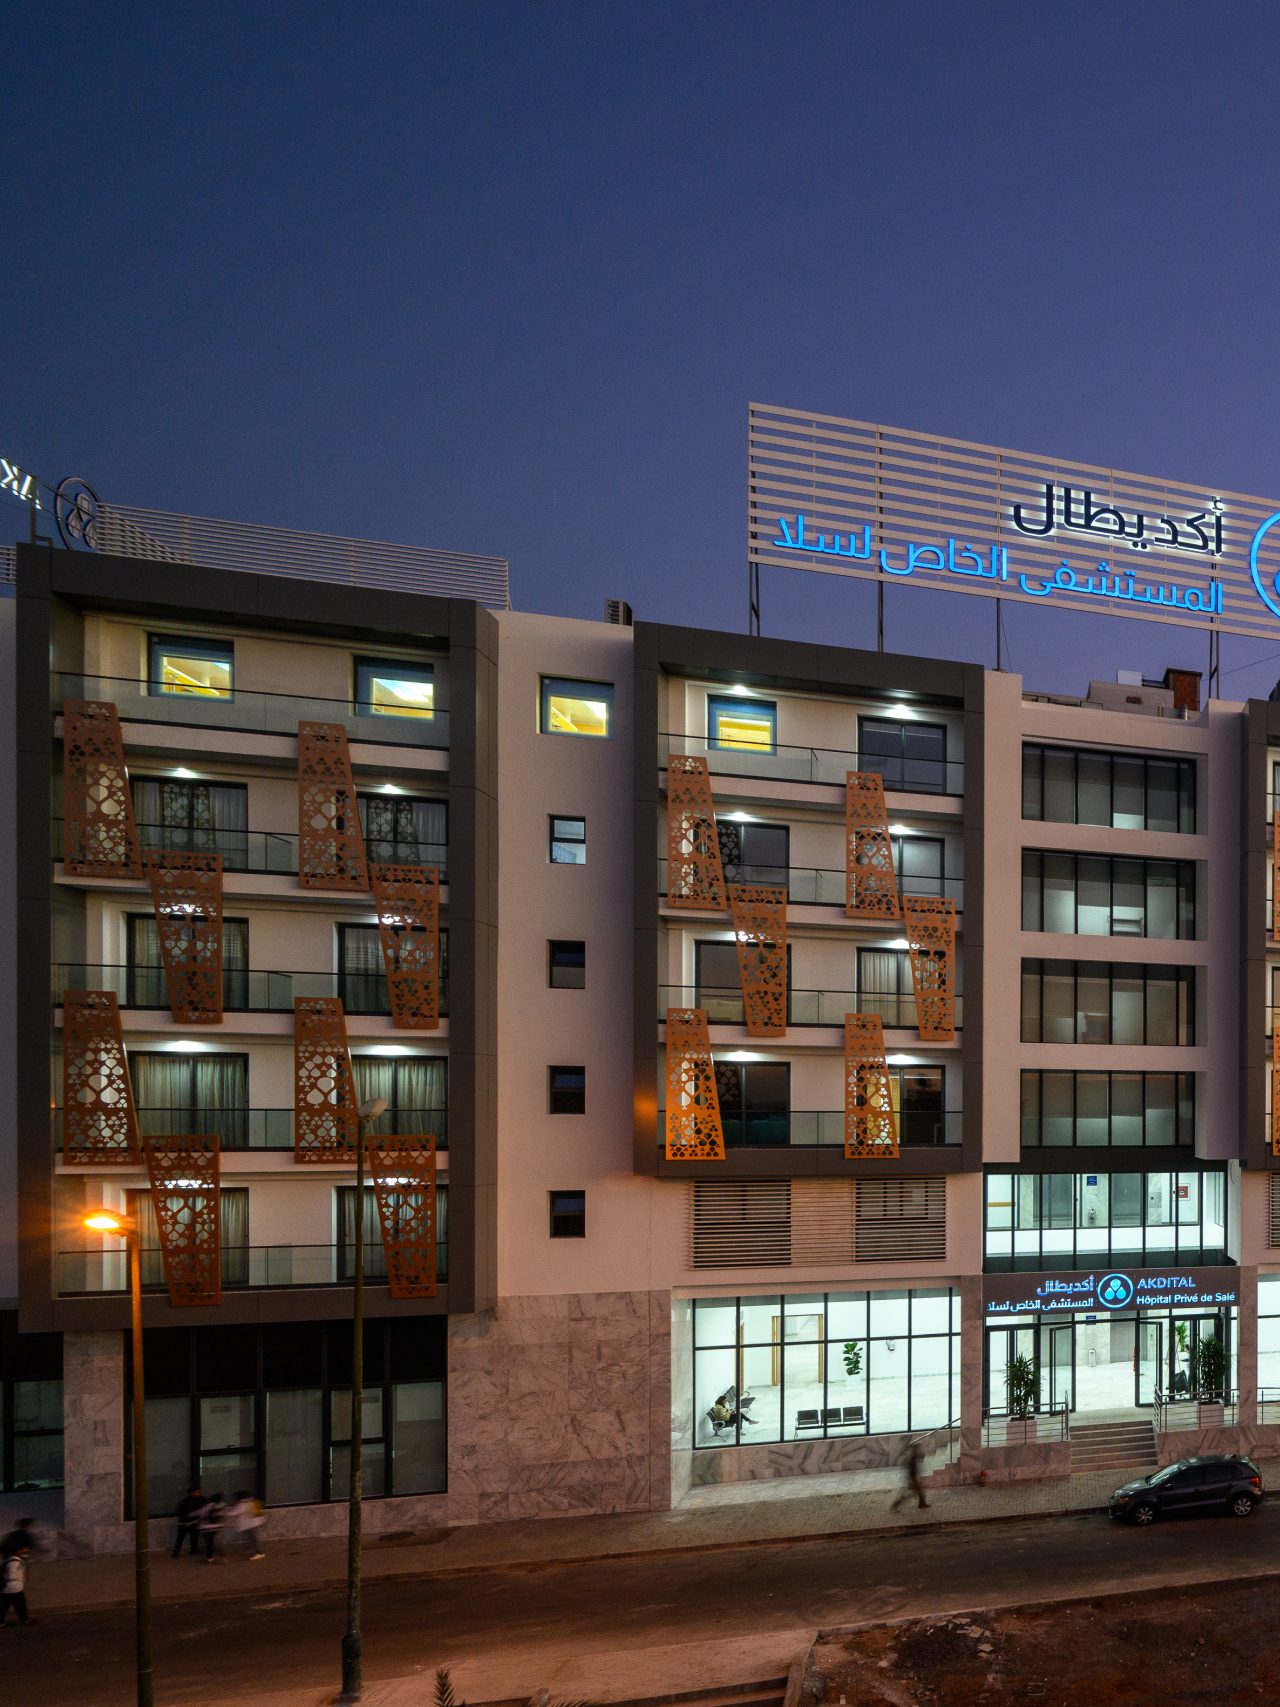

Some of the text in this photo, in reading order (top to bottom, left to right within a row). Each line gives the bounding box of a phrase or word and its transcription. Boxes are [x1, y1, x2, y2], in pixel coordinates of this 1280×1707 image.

[1013, 484, 1223, 556] أكديطال
[772, 515, 1223, 615] المستشفى الخاص لسلا
[1037, 1274, 1094, 1297] أكديطال
[1137, 1276, 1197, 1289] AKDITAL
[987, 1297, 1094, 1313] المستشفى الخاص لسلا
[1136, 1291, 1236, 1306] Hôpital Privé de Salé
